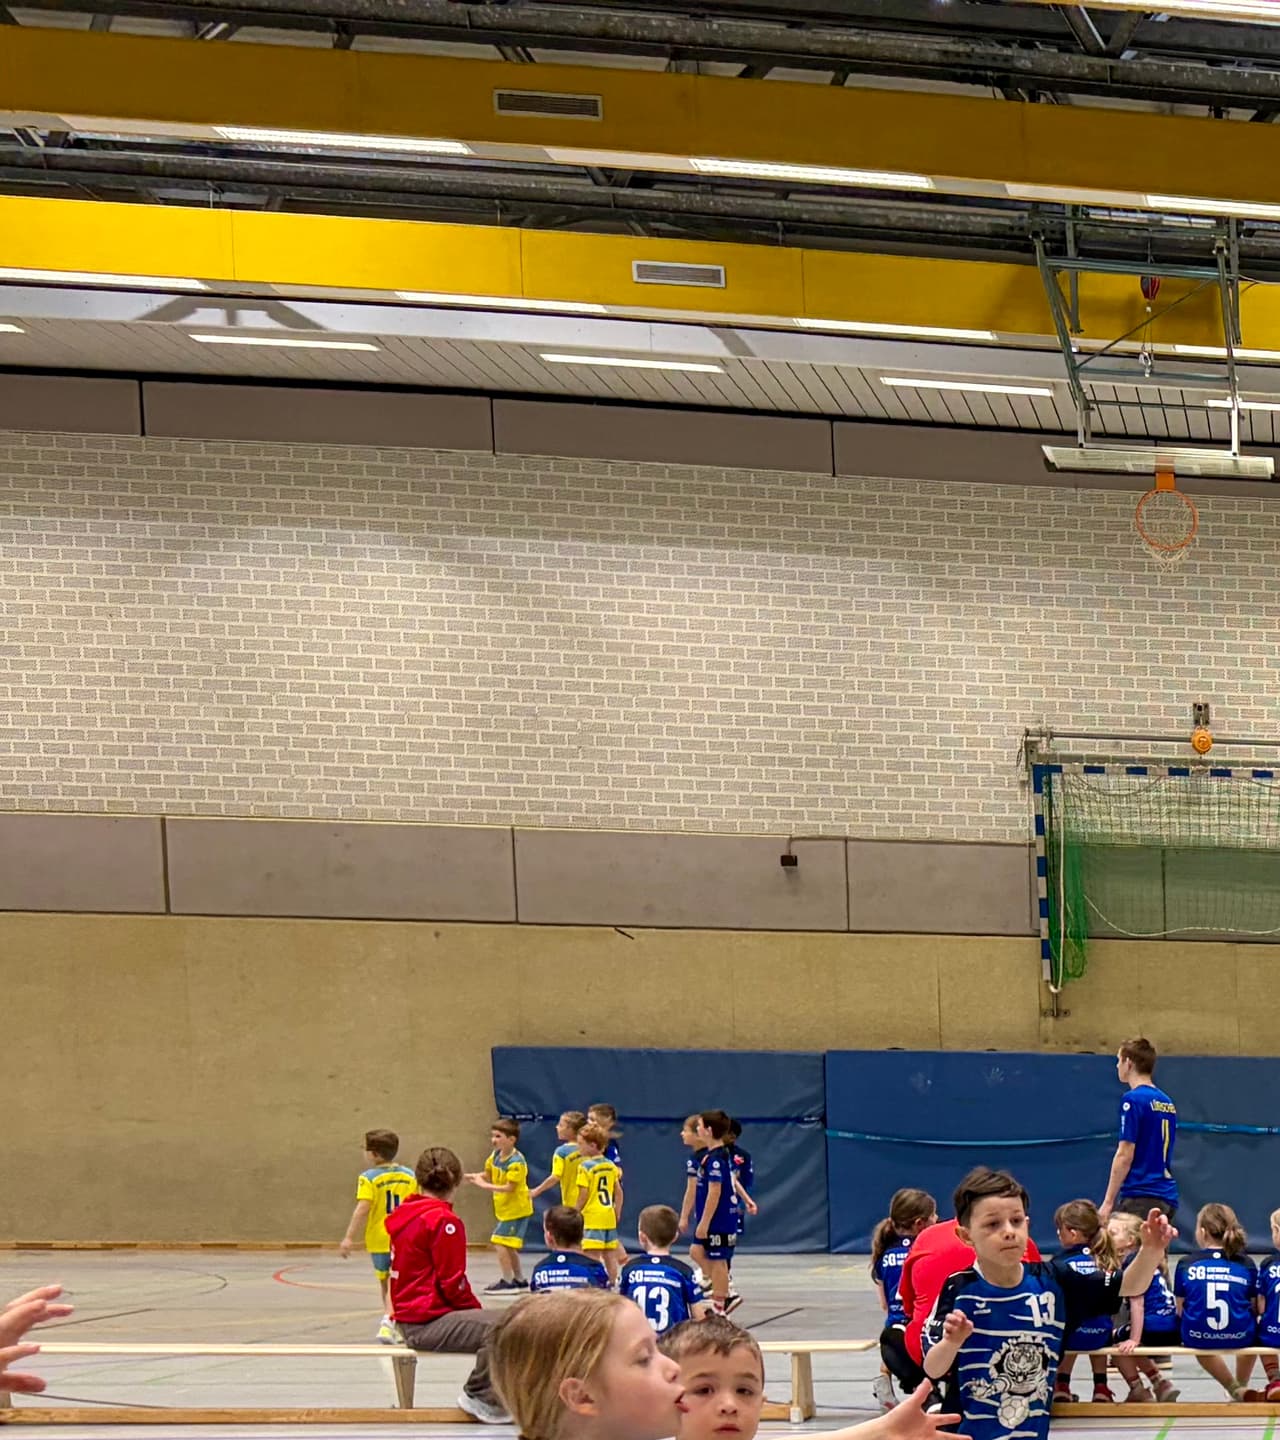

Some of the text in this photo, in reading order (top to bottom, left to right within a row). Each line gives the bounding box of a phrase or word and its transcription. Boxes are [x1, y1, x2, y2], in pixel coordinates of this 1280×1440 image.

[535, 1270, 548, 1285] SG
[628, 1270, 643, 1283] SG
[1188, 1266, 1206, 1280] SG
[633, 1286, 670, 1331] 13
[1026, 1291, 1056, 1328] 13
[1206, 1282, 1229, 1330] 5
